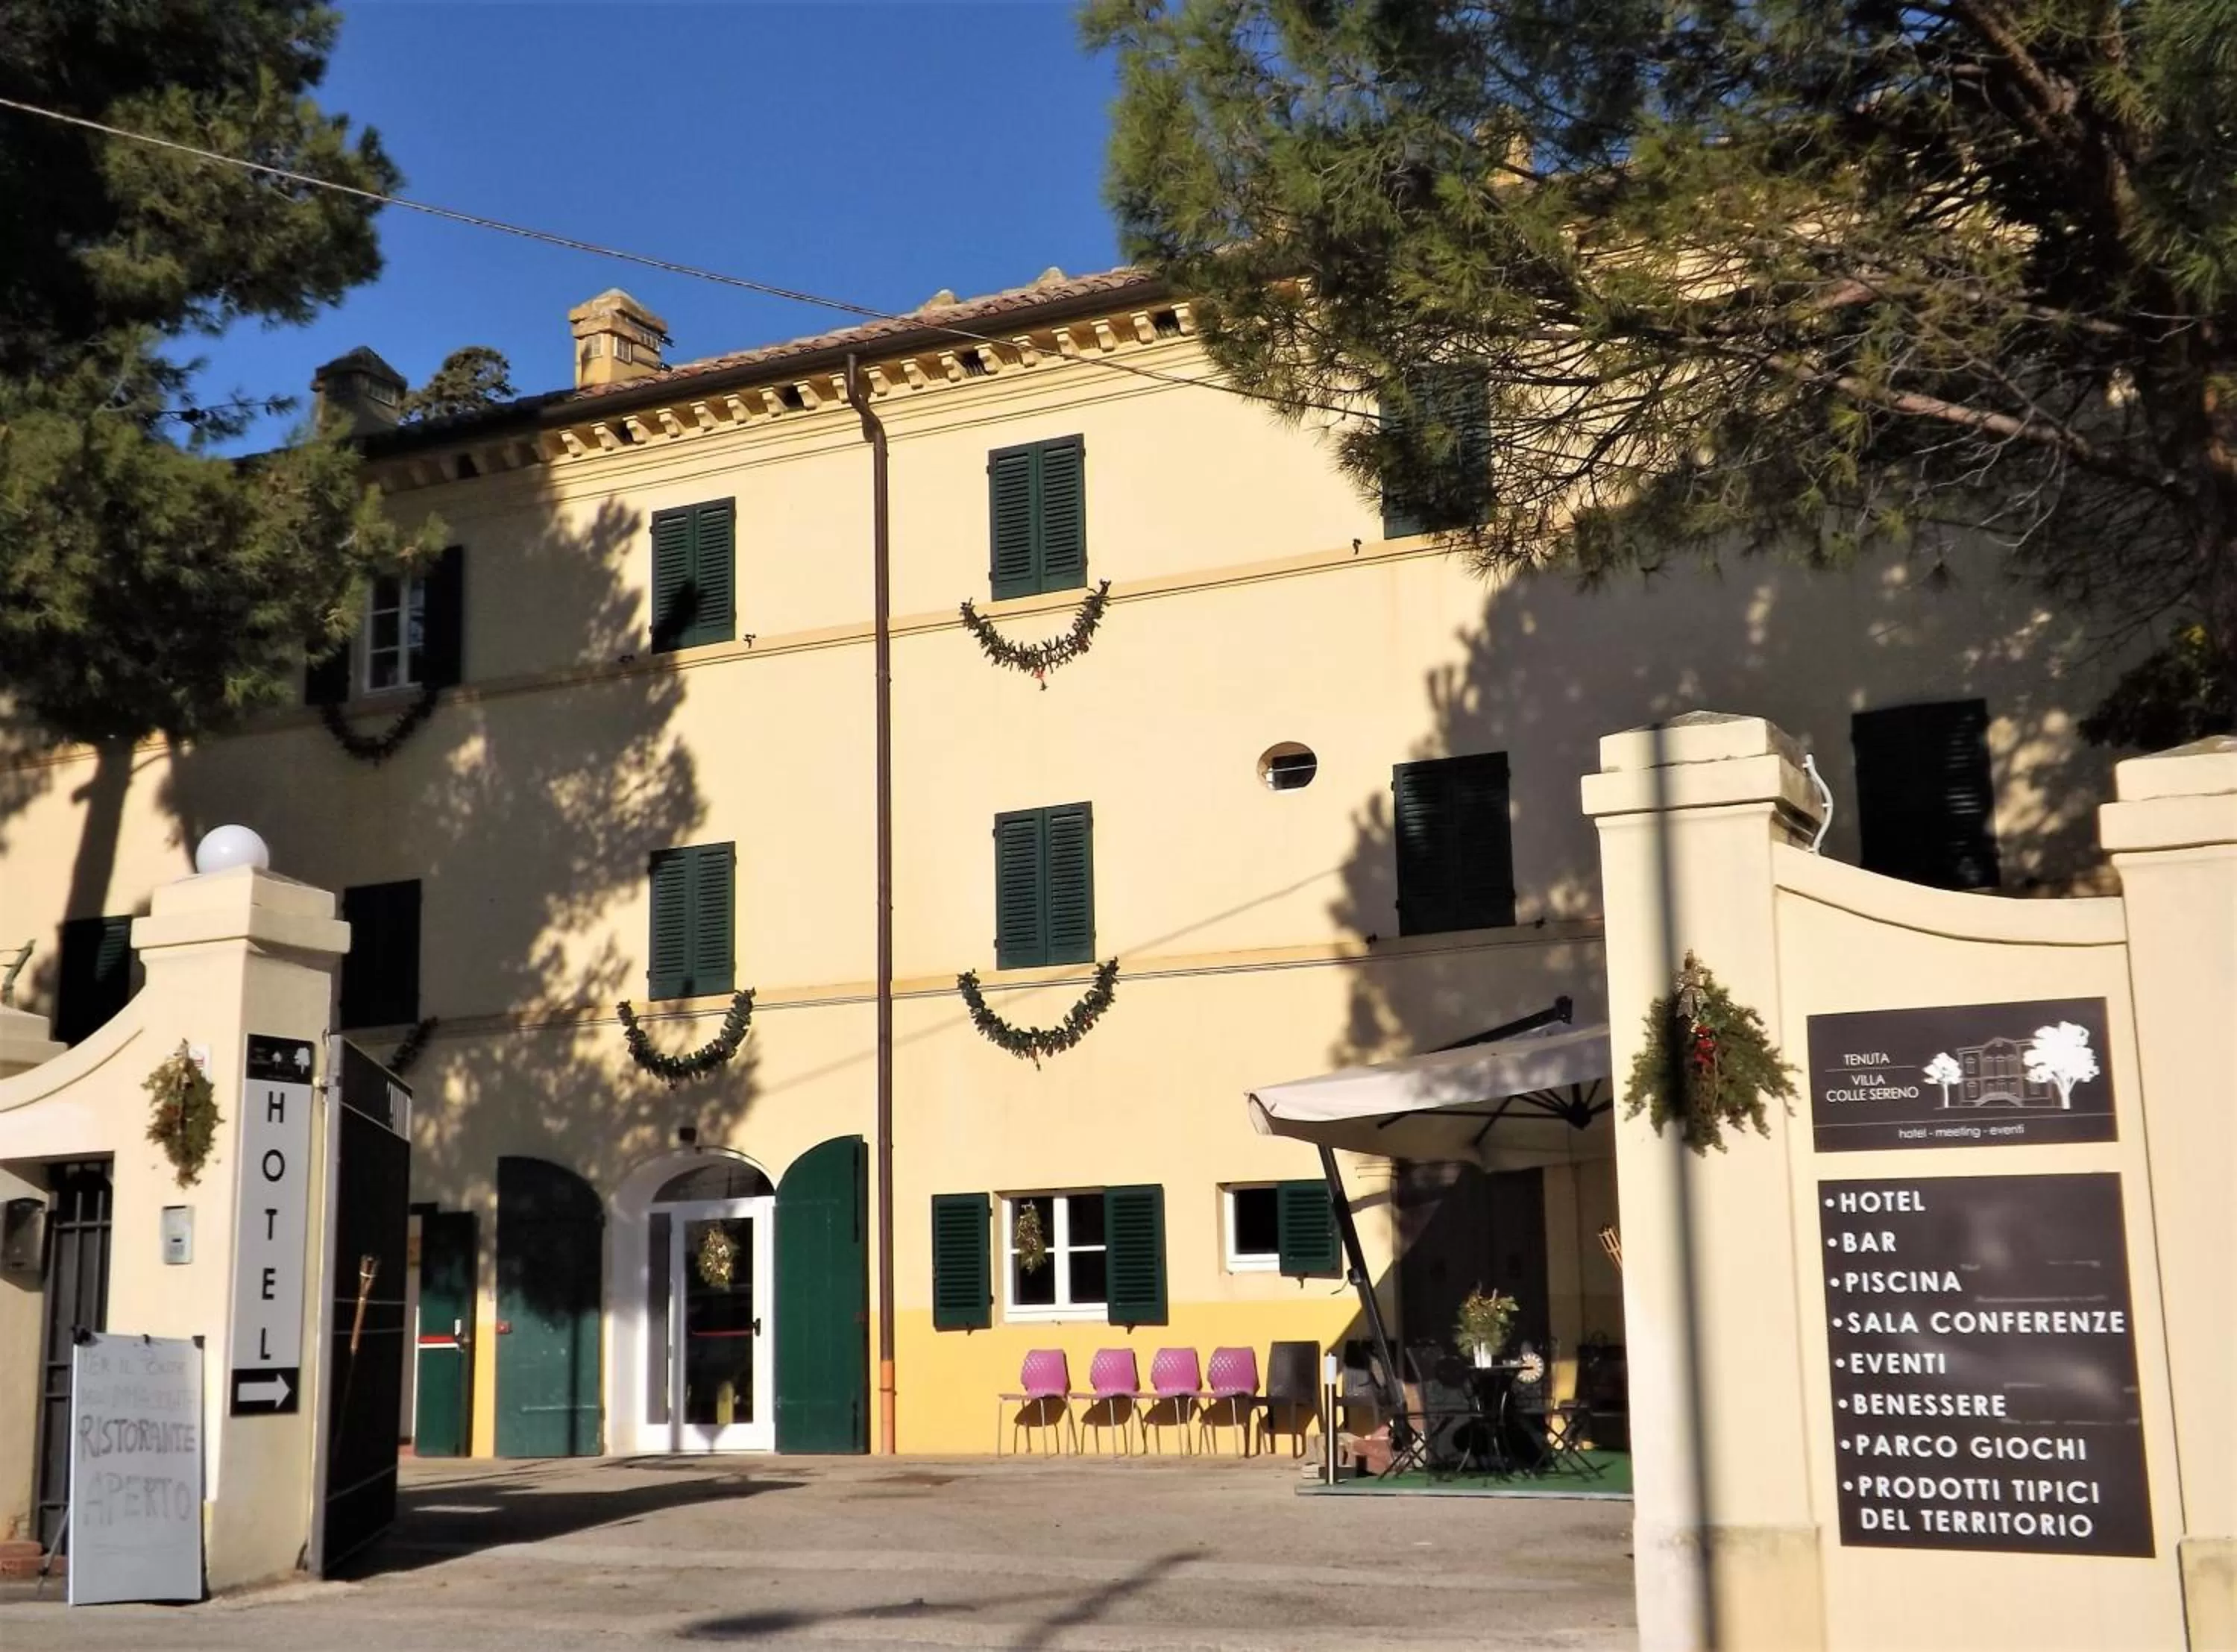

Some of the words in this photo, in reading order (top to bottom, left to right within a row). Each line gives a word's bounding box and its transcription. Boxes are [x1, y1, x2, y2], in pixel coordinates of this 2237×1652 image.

[1843, 1052, 1890, 1066] TENUTA
[1851, 1074, 1886, 1086] VILLA
[1825, 1088, 1867, 1103] COLLE
[1869, 1086, 1919, 1100] SERENO
[1898, 1126, 1928, 1140] hotel
[1934, 1126, 1982, 1140] meeting
[1989, 1123, 2025, 1137] eventi
[1840, 1191, 1926, 1213] HOTEL
[259, 1091, 286, 1361] HOTEL
[1843, 1231, 1896, 1253] BAR
[1845, 1271, 1963, 1293] PISCINA
[1847, 1311, 1919, 1334] SALA
[1930, 1311, 2124, 1334] CONFERENZE
[1850, 1352, 1946, 1374] EVENTI
[1853, 1393, 2007, 1417] BENESSERE
[79, 1413, 197, 1462] RISTORANTE
[1856, 1434, 1957, 1457] PARCO
[1970, 1436, 2086, 1460] GIOCHI
[83, 1471, 193, 1526] APERTO
[1858, 1475, 2001, 1501] PRODOTTI
[2011, 1479, 2099, 1504] TIPICI
[1860, 1507, 1910, 1530] DEL
[1920, 1510, 2093, 1537] TERRITORIO
